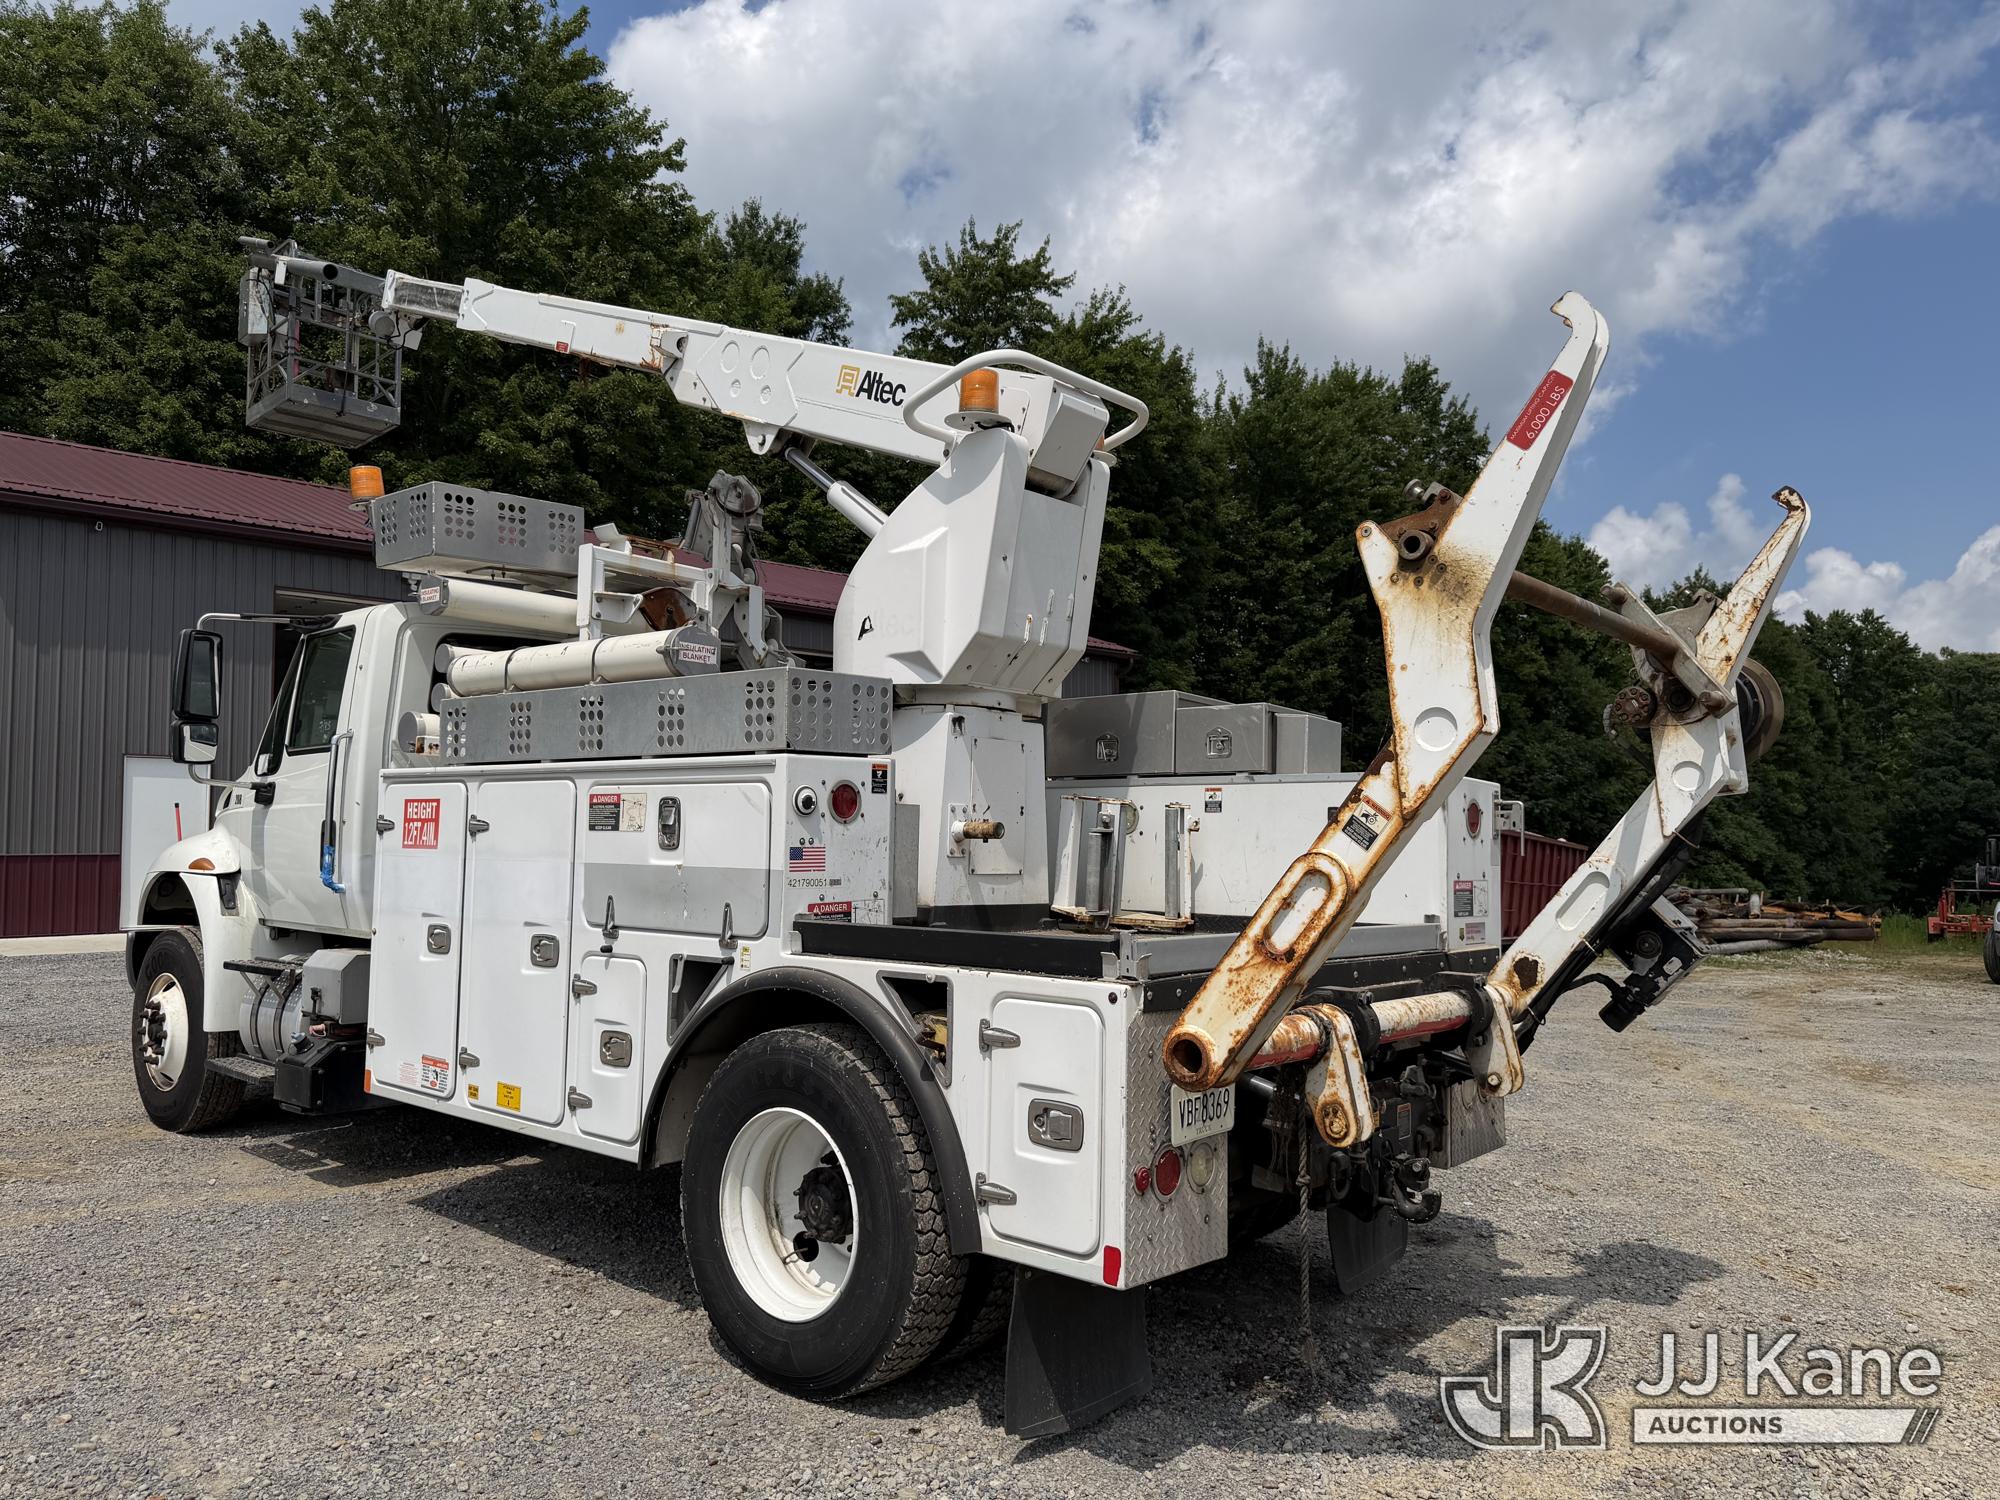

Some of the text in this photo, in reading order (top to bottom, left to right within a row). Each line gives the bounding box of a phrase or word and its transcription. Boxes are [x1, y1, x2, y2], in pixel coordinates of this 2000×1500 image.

[855, 370, 906, 406] Altec
[1526, 385, 1565, 439] 6,000 LBS
[682, 651, 711, 662] BLANKET
[407, 801, 438, 819] HEIGHT
[787, 878, 827, 888] 421790051
[820, 903, 848, 913] DANGER
